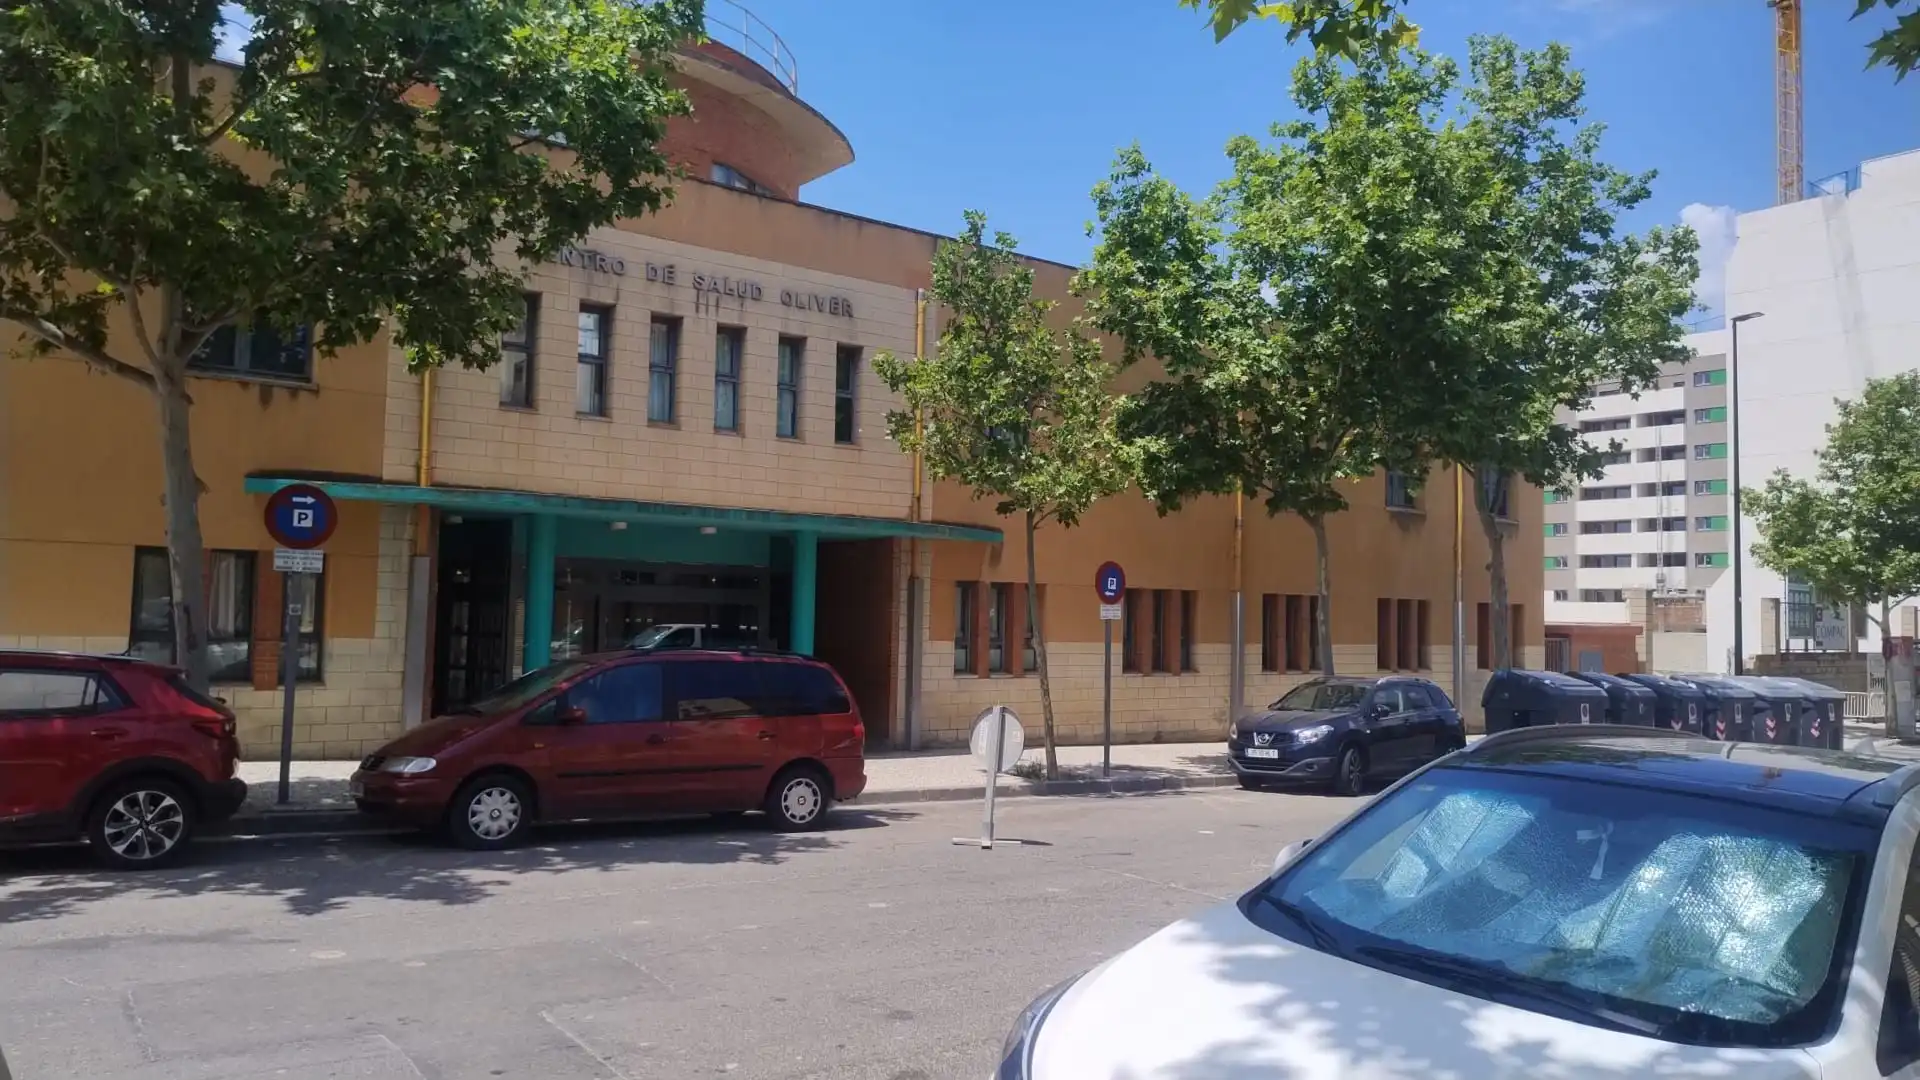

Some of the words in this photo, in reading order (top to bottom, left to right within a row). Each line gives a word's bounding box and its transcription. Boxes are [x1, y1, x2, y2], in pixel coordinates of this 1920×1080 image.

[554, 246, 626, 276] NTRO
[645, 262, 678, 286] DE
[692, 272, 765, 301] SALUD
[780, 289, 854, 317] OLIVER
[298, 512, 309, 524] P
